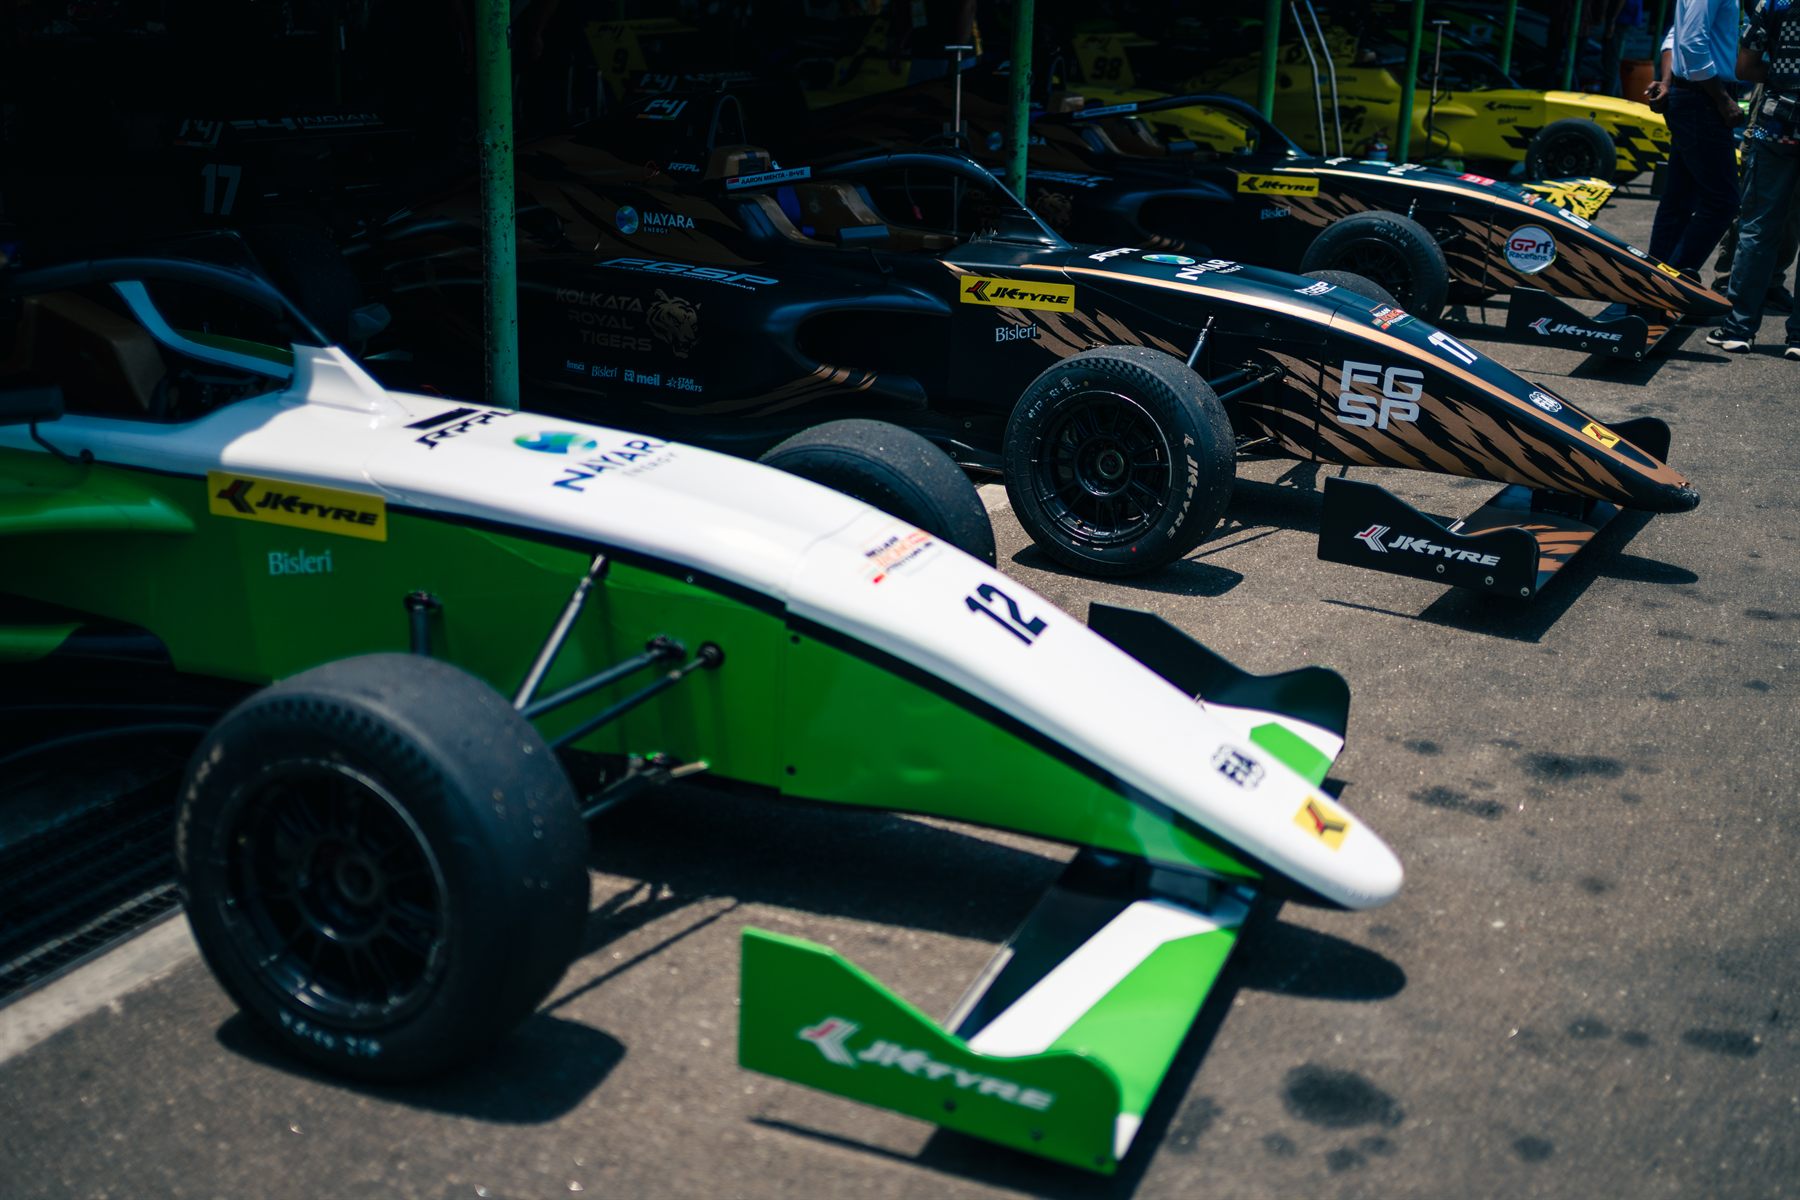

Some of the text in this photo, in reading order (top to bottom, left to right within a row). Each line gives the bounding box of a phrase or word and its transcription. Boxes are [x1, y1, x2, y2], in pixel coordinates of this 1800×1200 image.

[741, 176, 763, 185] AARON
[764, 172, 785, 181] MEHTA
[202, 164, 242, 216] 17
[643, 211, 695, 229] NAYARA
[556, 288, 643, 313] KOLKATA
[568, 309, 635, 331] ROYAL
[580, 329, 652, 352] TIGERS
[995, 323, 1039, 343] Bisleri
[1428, 331, 1478, 365] 17
[592, 365, 618, 378] Bisleri
[637, 373, 660, 386] meil
[678, 377, 695, 385] STAR
[1341, 360, 1424, 401] FG
[678, 383, 703, 393] SPORTS
[1337, 393, 1420, 429] SP
[268, 549, 332, 576] Bisleri
[964, 583, 1047, 646] 12
